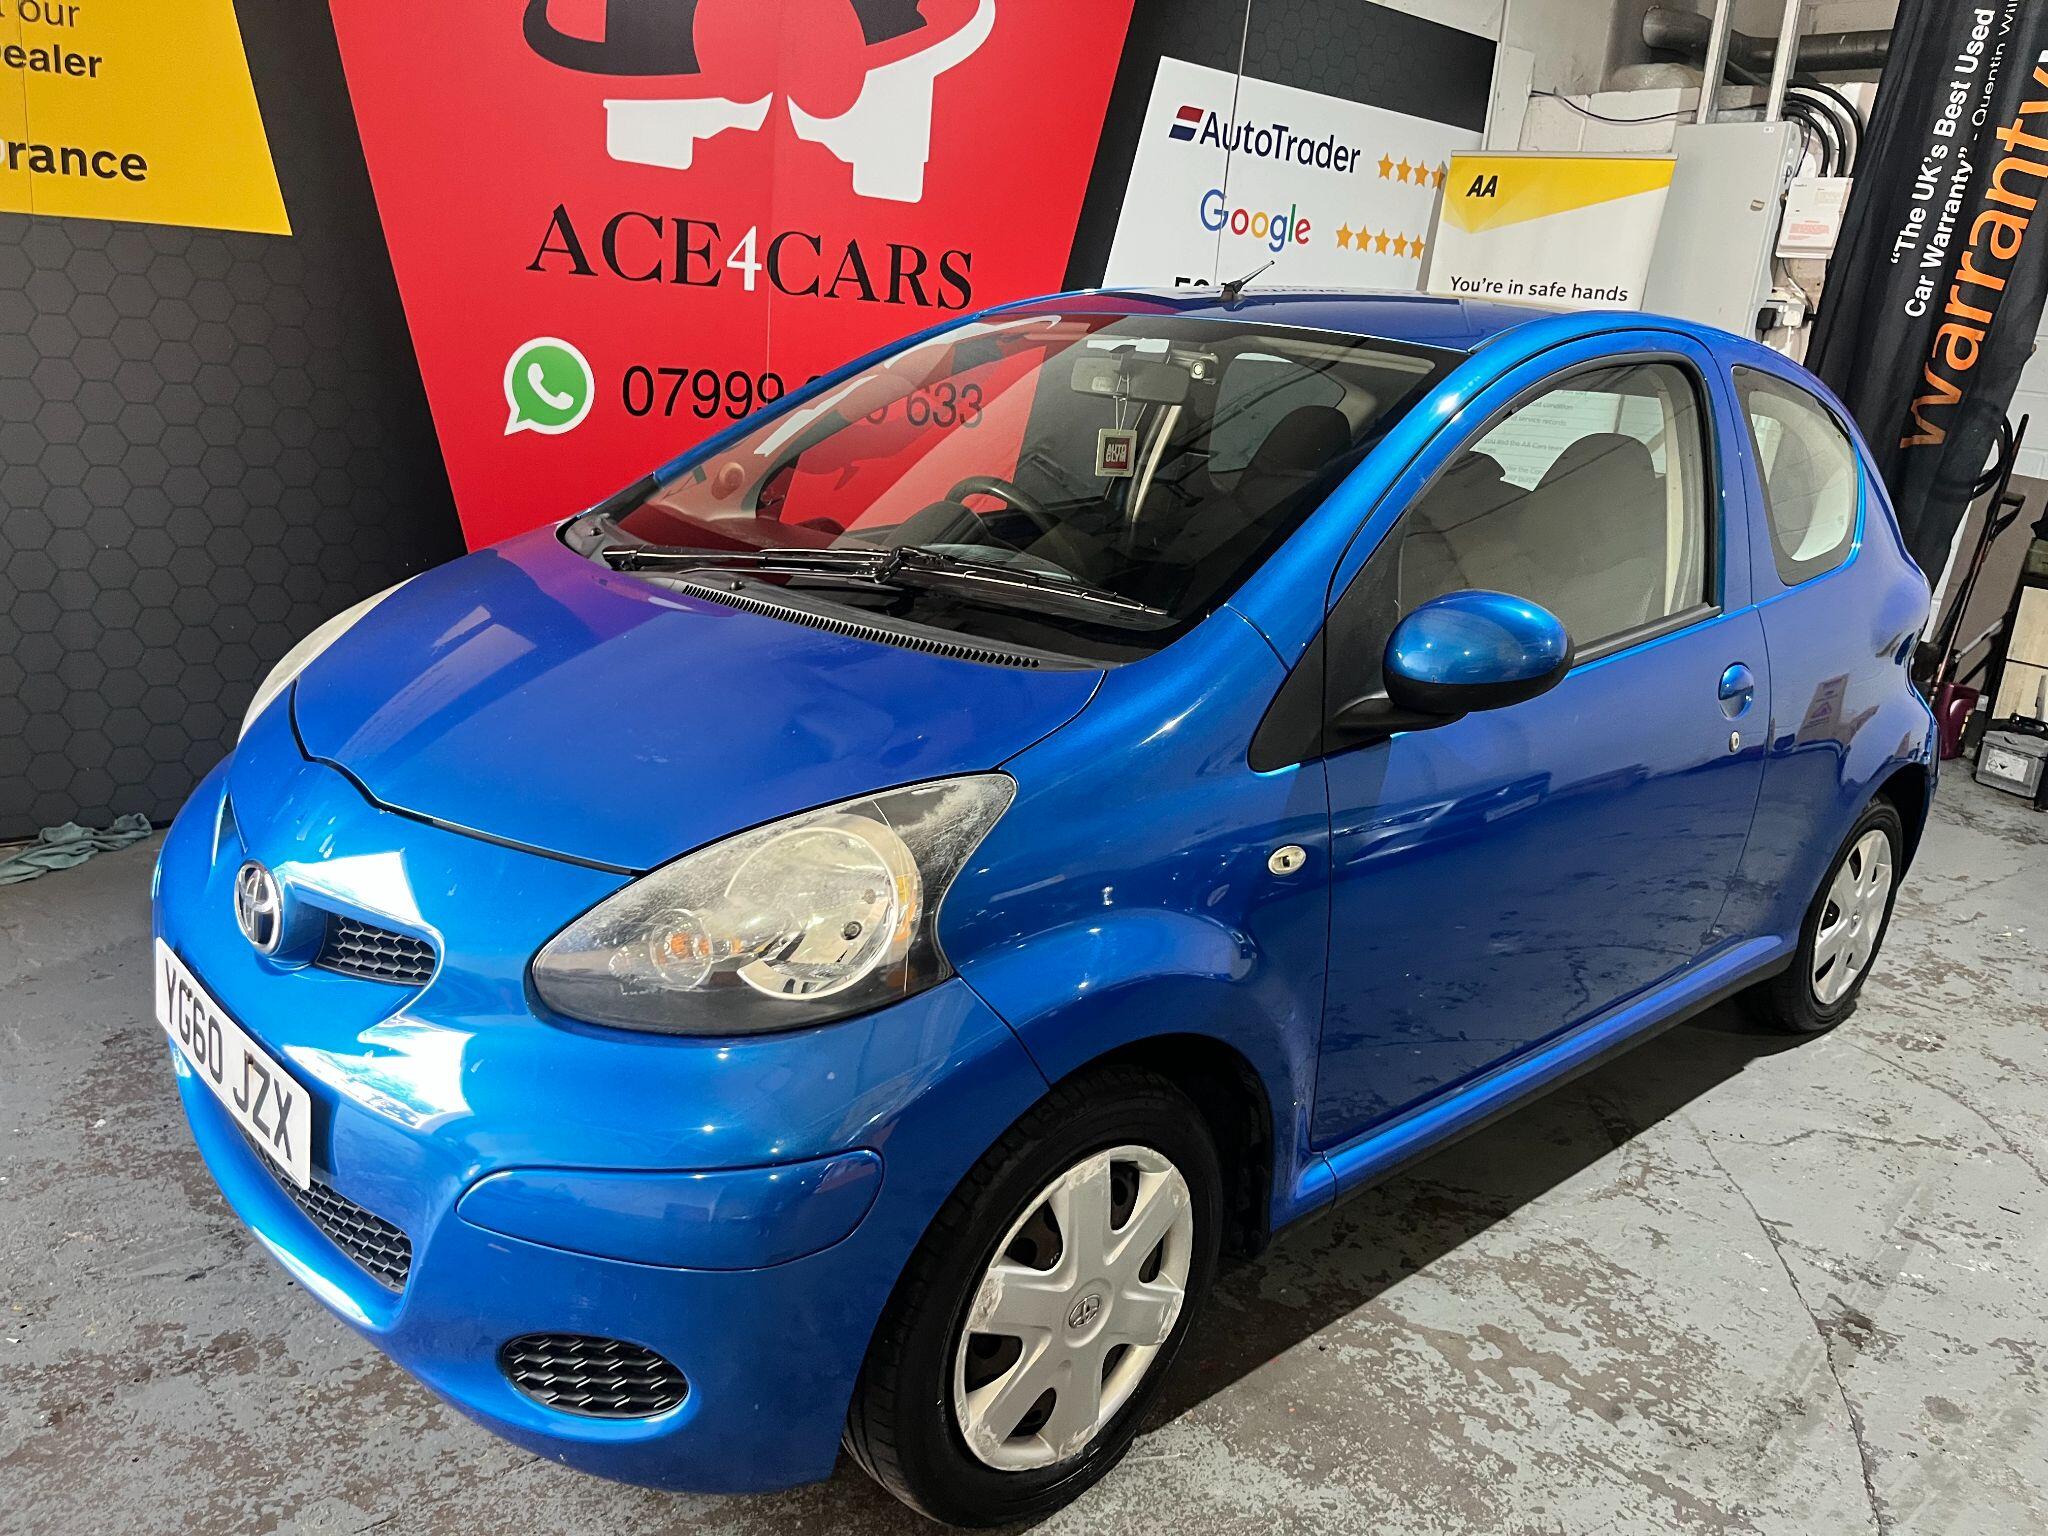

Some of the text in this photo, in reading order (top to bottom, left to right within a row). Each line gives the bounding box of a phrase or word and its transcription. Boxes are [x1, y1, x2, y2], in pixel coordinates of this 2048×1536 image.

[18, 0, 80, 28] our
[0, 44, 103, 78] ealer
[1932, 81, 1972, 138] Best
[1954, 8, 1996, 74] Used
[1199, 111, 1361, 174] AutoTrader
[1465, 174, 1499, 198] AA
[1904, 274, 1935, 318] Car
[1972, 43, 2006, 127] Quentin
[1200, 189, 1311, 252] Google
[525, 203, 973, 310] ACE4CARS
[1450, 276, 1629, 302] You’re in safe hands
[622, 365, 785, 418] 07999
[165, 958, 292, 1162] YG60 JZX
